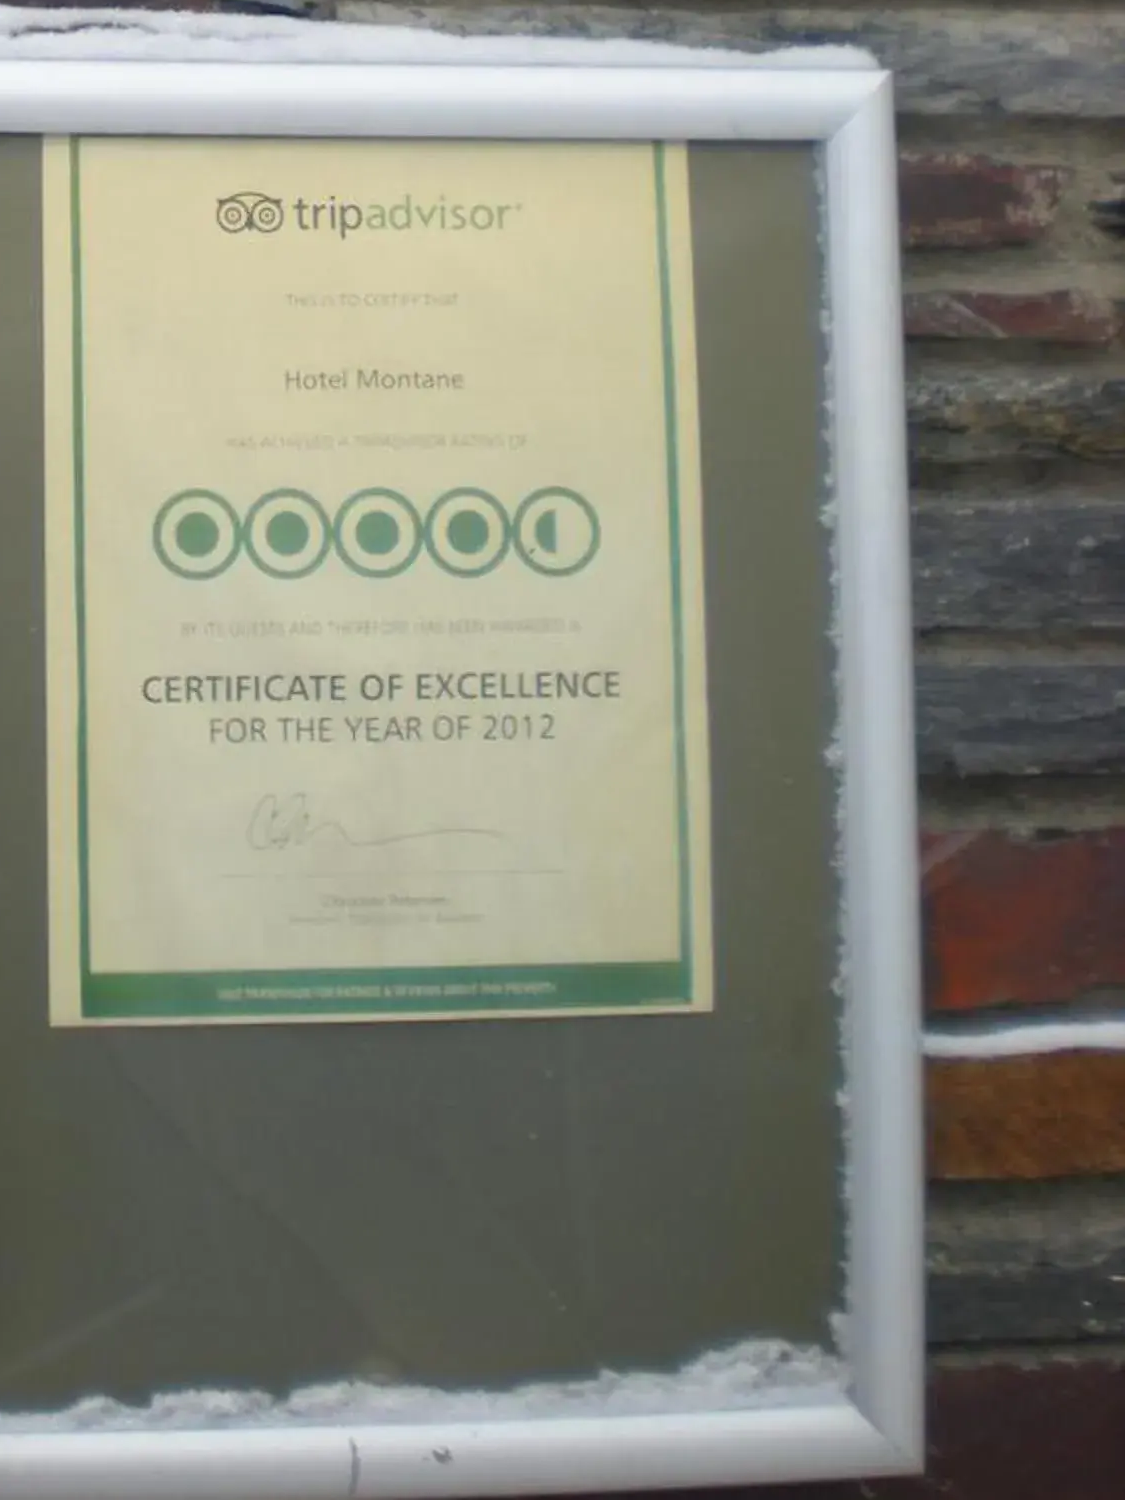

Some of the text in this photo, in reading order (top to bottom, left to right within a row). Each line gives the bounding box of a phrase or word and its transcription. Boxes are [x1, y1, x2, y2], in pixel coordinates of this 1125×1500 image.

[292, 193, 509, 240] tripadvisor
[284, 369, 464, 391] Hotel Montane
[141, 670, 622, 704] CERTIFICATE OF EXCELLENCE
[208, 713, 557, 744] FOR THE YEAR OF 2012
